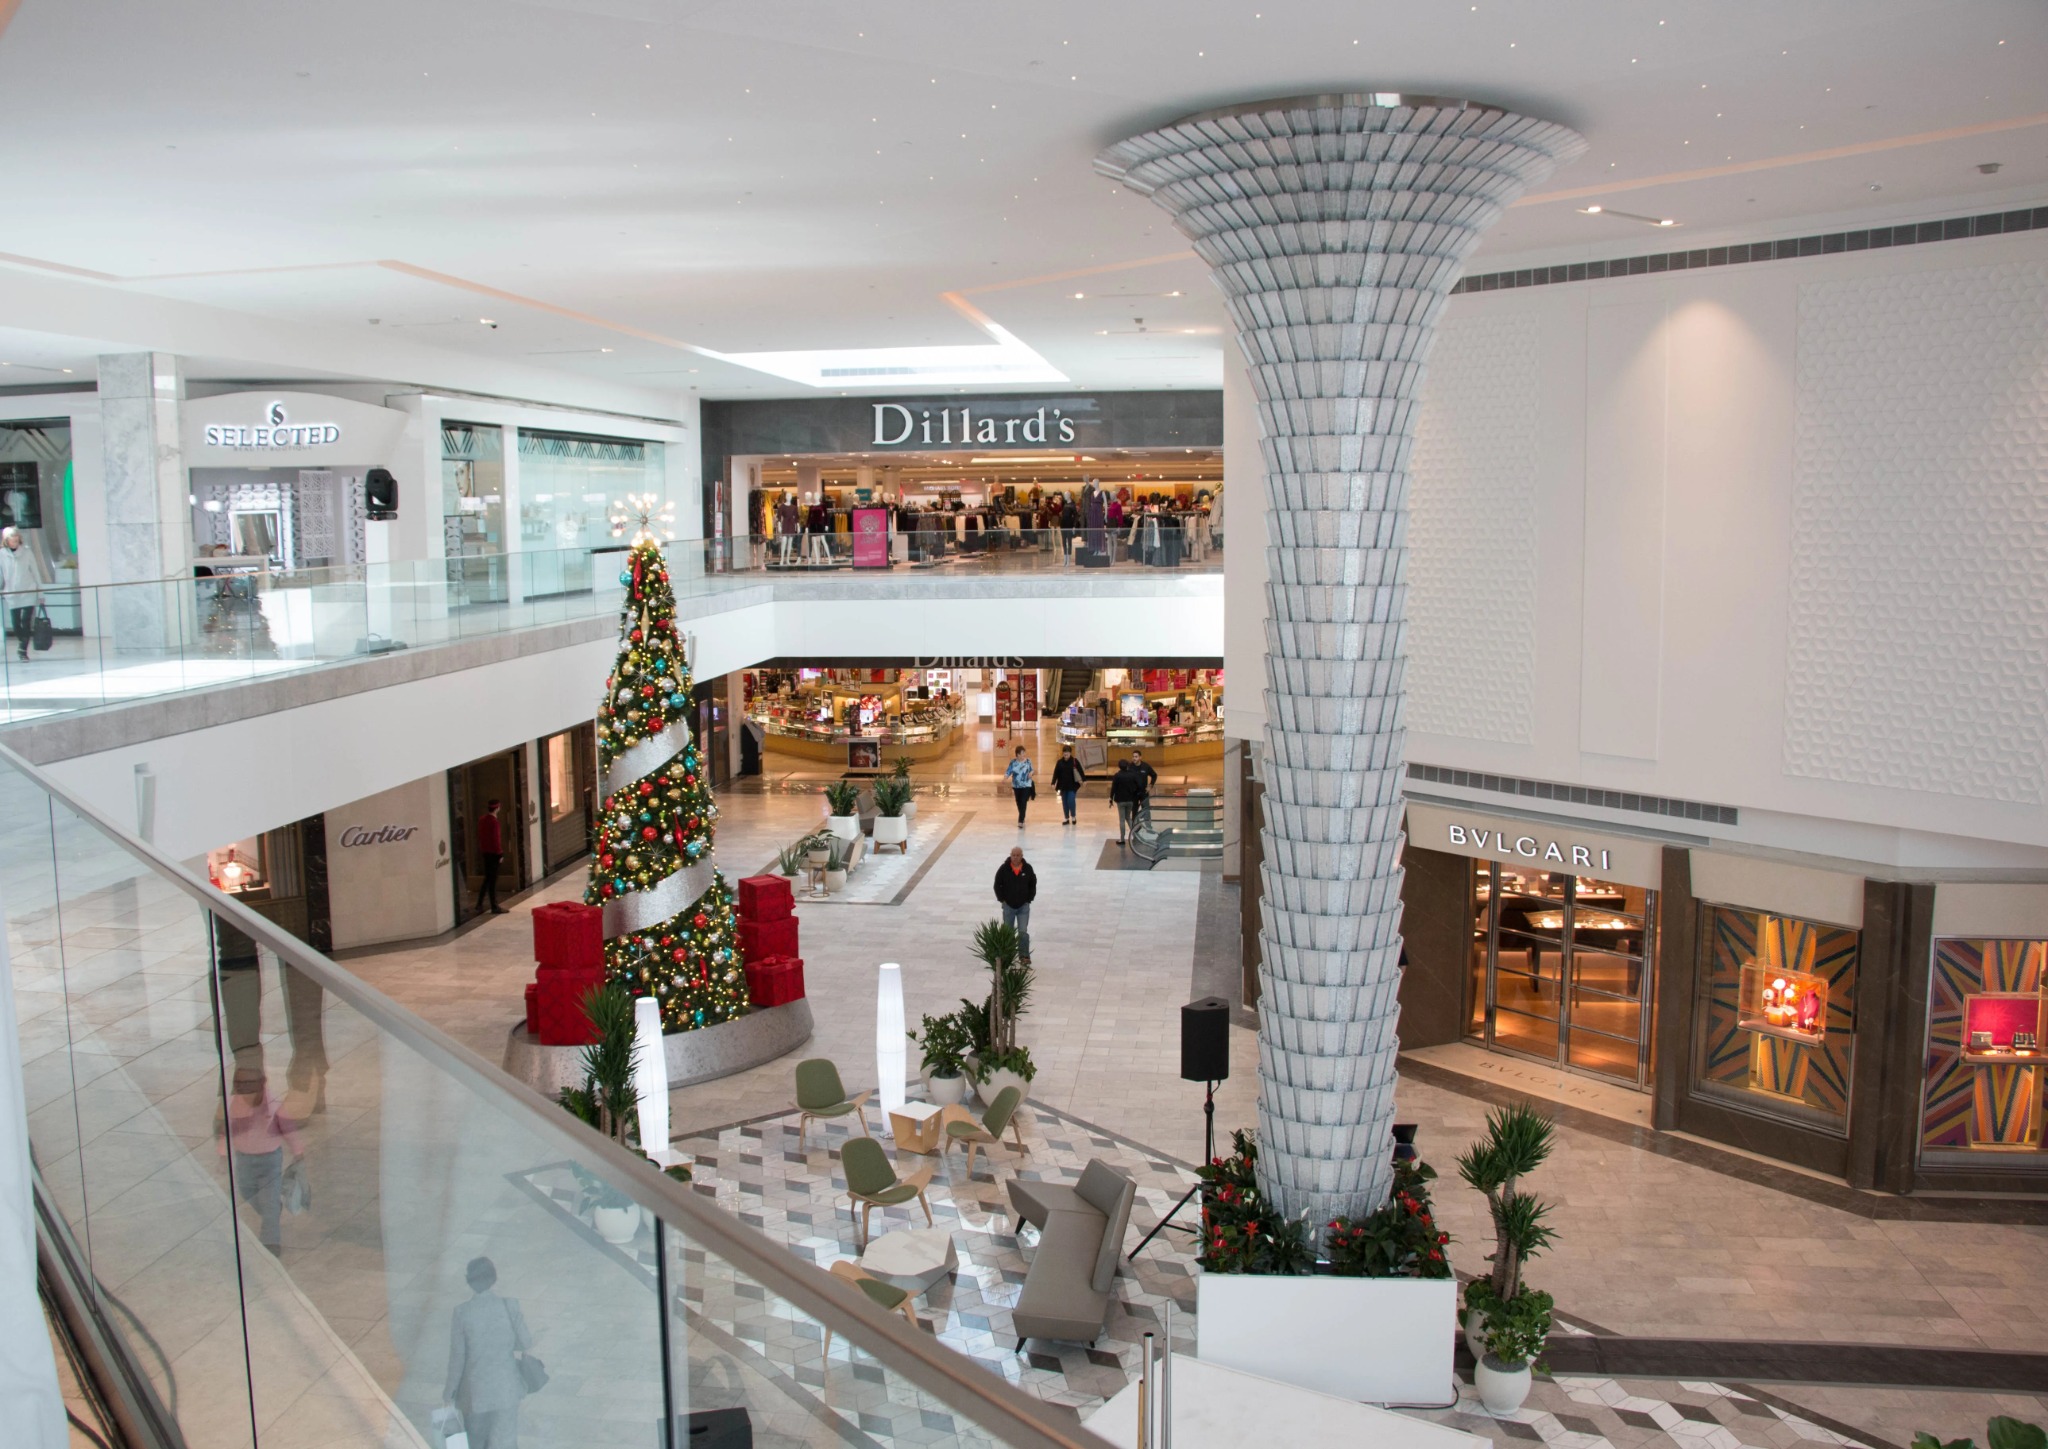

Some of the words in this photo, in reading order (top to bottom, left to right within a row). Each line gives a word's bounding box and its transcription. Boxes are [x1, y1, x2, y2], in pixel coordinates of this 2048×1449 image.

[206, 425, 340, 447] SELECTED
[871, 403, 1075, 445] Dillard's
[340, 825, 419, 848] Cartier
[1449, 825, 1611, 870] BVLGARI
[1478, 1061, 1600, 1099] BVLGARI
